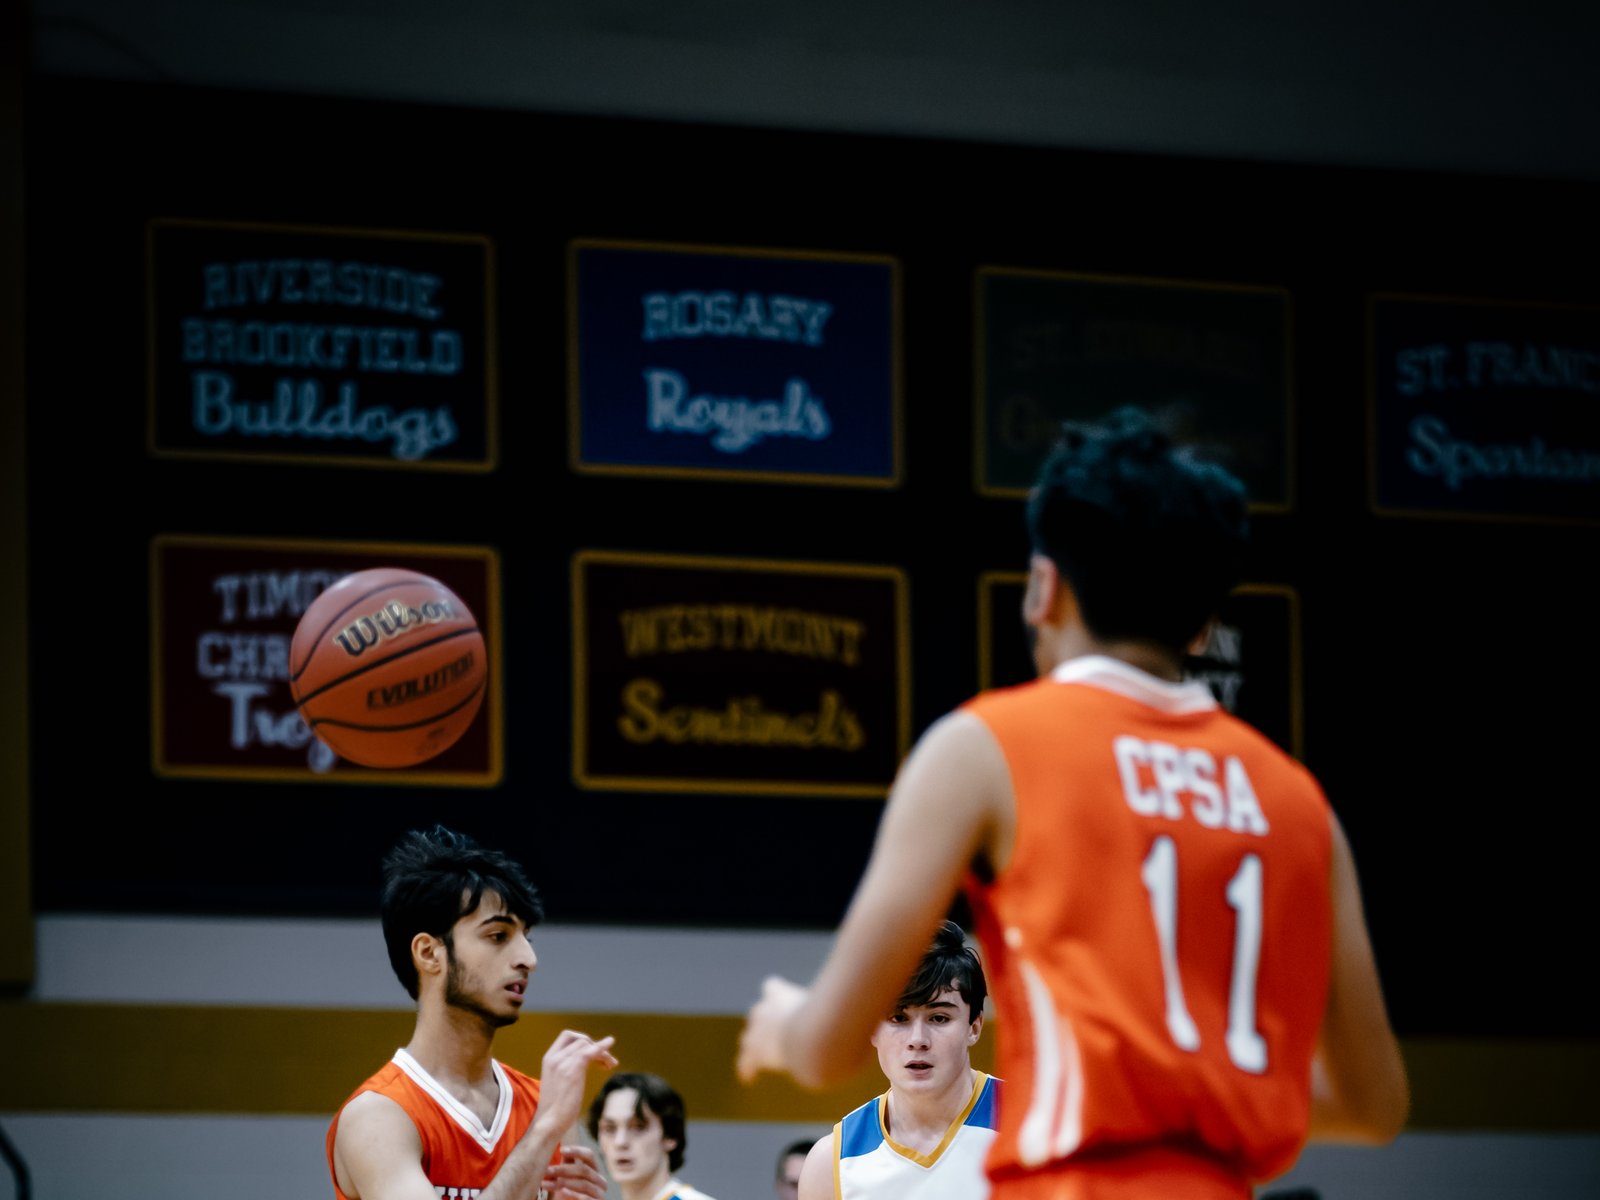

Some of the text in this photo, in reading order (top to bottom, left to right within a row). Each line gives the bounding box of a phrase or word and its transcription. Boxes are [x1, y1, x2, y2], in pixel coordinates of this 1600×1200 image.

[203, 258, 444, 320] RIVERSIDE
[643, 291, 833, 345] ROSARY
[181, 316, 463, 374] BROOKFIELD
[191, 370, 459, 460] Bulldogs
[644, 369, 832, 452] Royals
[212, 569, 352, 621] TIMO
[332, 600, 462, 657] Wilson
[618, 602, 866, 666] WESTMONT
[366, 652, 474, 711] EVOLUTION
[617, 677, 865, 751] Sentinels
[1114, 737, 1269, 834] CPSA
[1142, 836, 1266, 1073] 11
